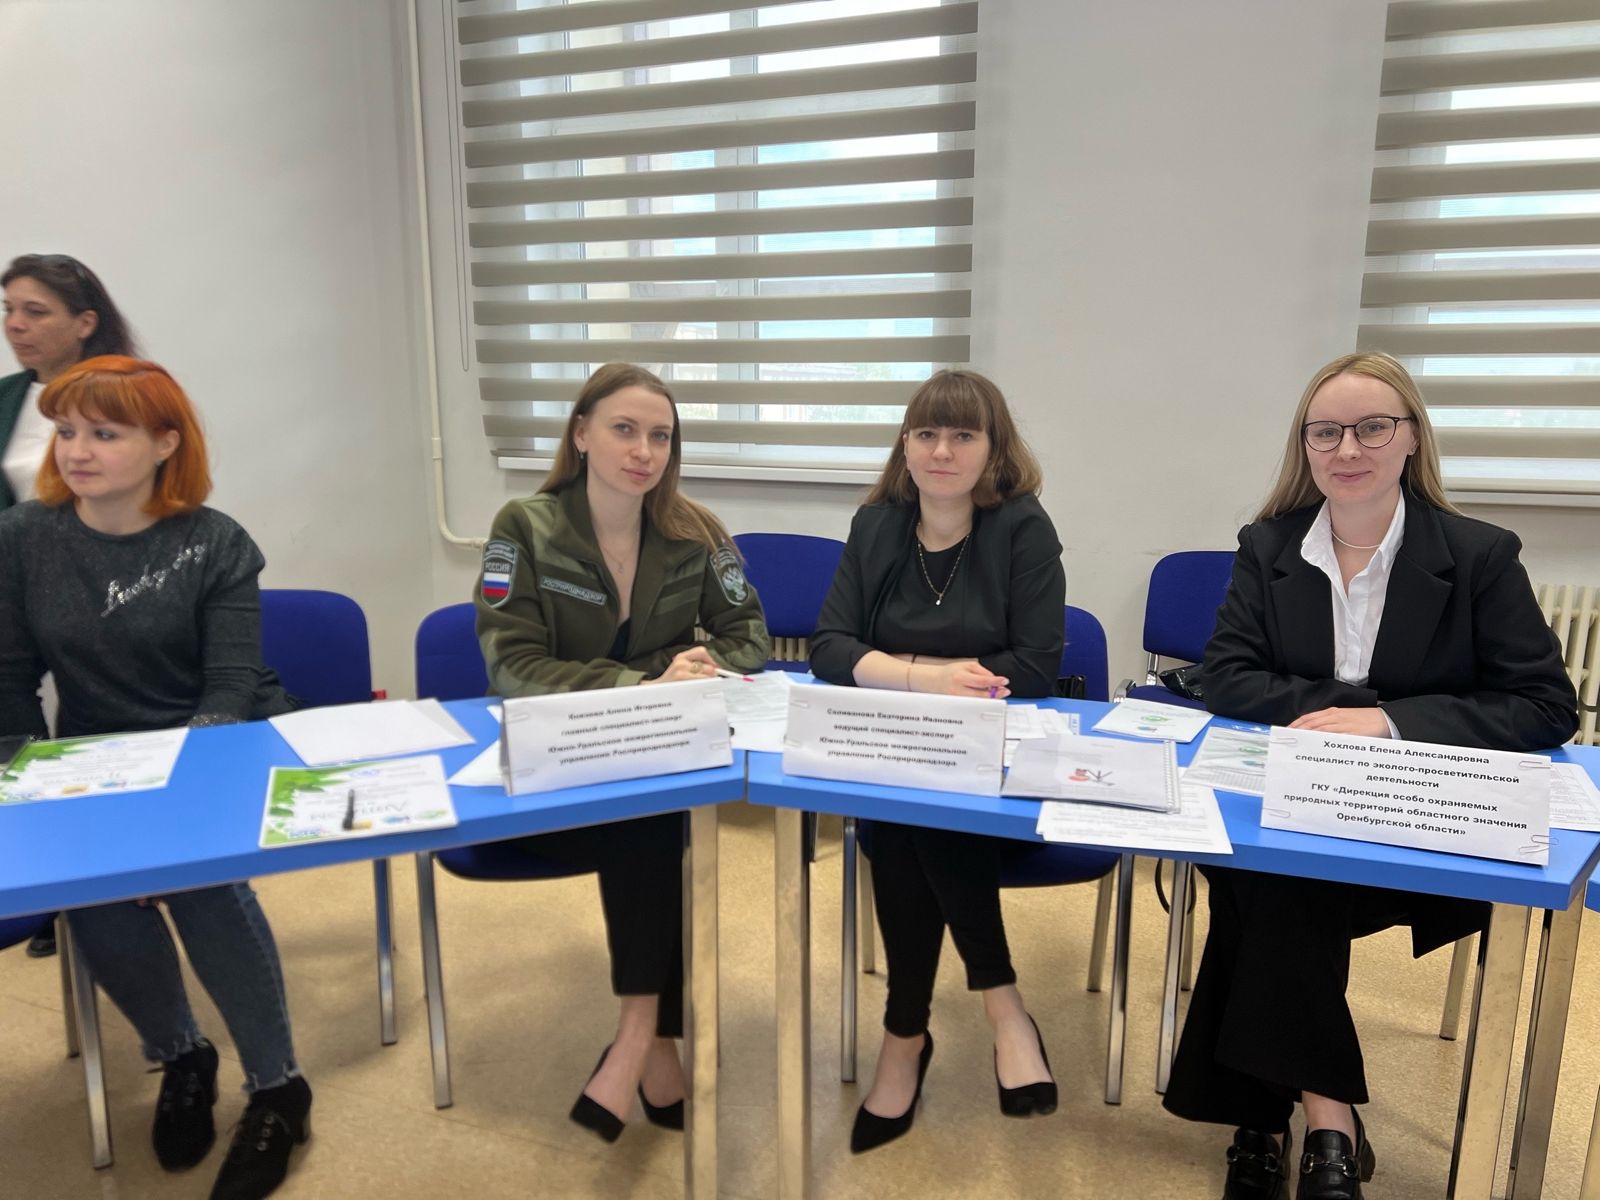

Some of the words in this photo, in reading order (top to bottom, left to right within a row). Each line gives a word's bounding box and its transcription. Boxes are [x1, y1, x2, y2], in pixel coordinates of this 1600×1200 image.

[877, 712, 920, 721] Екатерина
[922, 716, 963, 724] Ивановна
[1324, 740, 1366, 752] Хохлова
[1370, 746, 1401, 755] Елена
[1404, 749, 1490, 764] Александровна
[1296, 754, 1355, 766] специалист
[1358, 760, 1370, 768] по
[1373, 762, 1520, 784] эколого-просветительской
[1366, 775, 1439, 788] деятельности
[1311, 783, 1330, 792] ГКУ
[1333, 786, 1390, 798] «Дирекция
[1393, 793, 1424, 803] особо
[1428, 798, 1498, 812] охраняемых
[1284, 794, 1340, 806] природных
[1343, 801, 1403, 814] территорий
[1407, 808, 1470, 822] областного
[1473, 817, 1527, 830] значения
[1336, 812, 1412, 828] Оренбургской
[1415, 822, 1466, 835] области»
